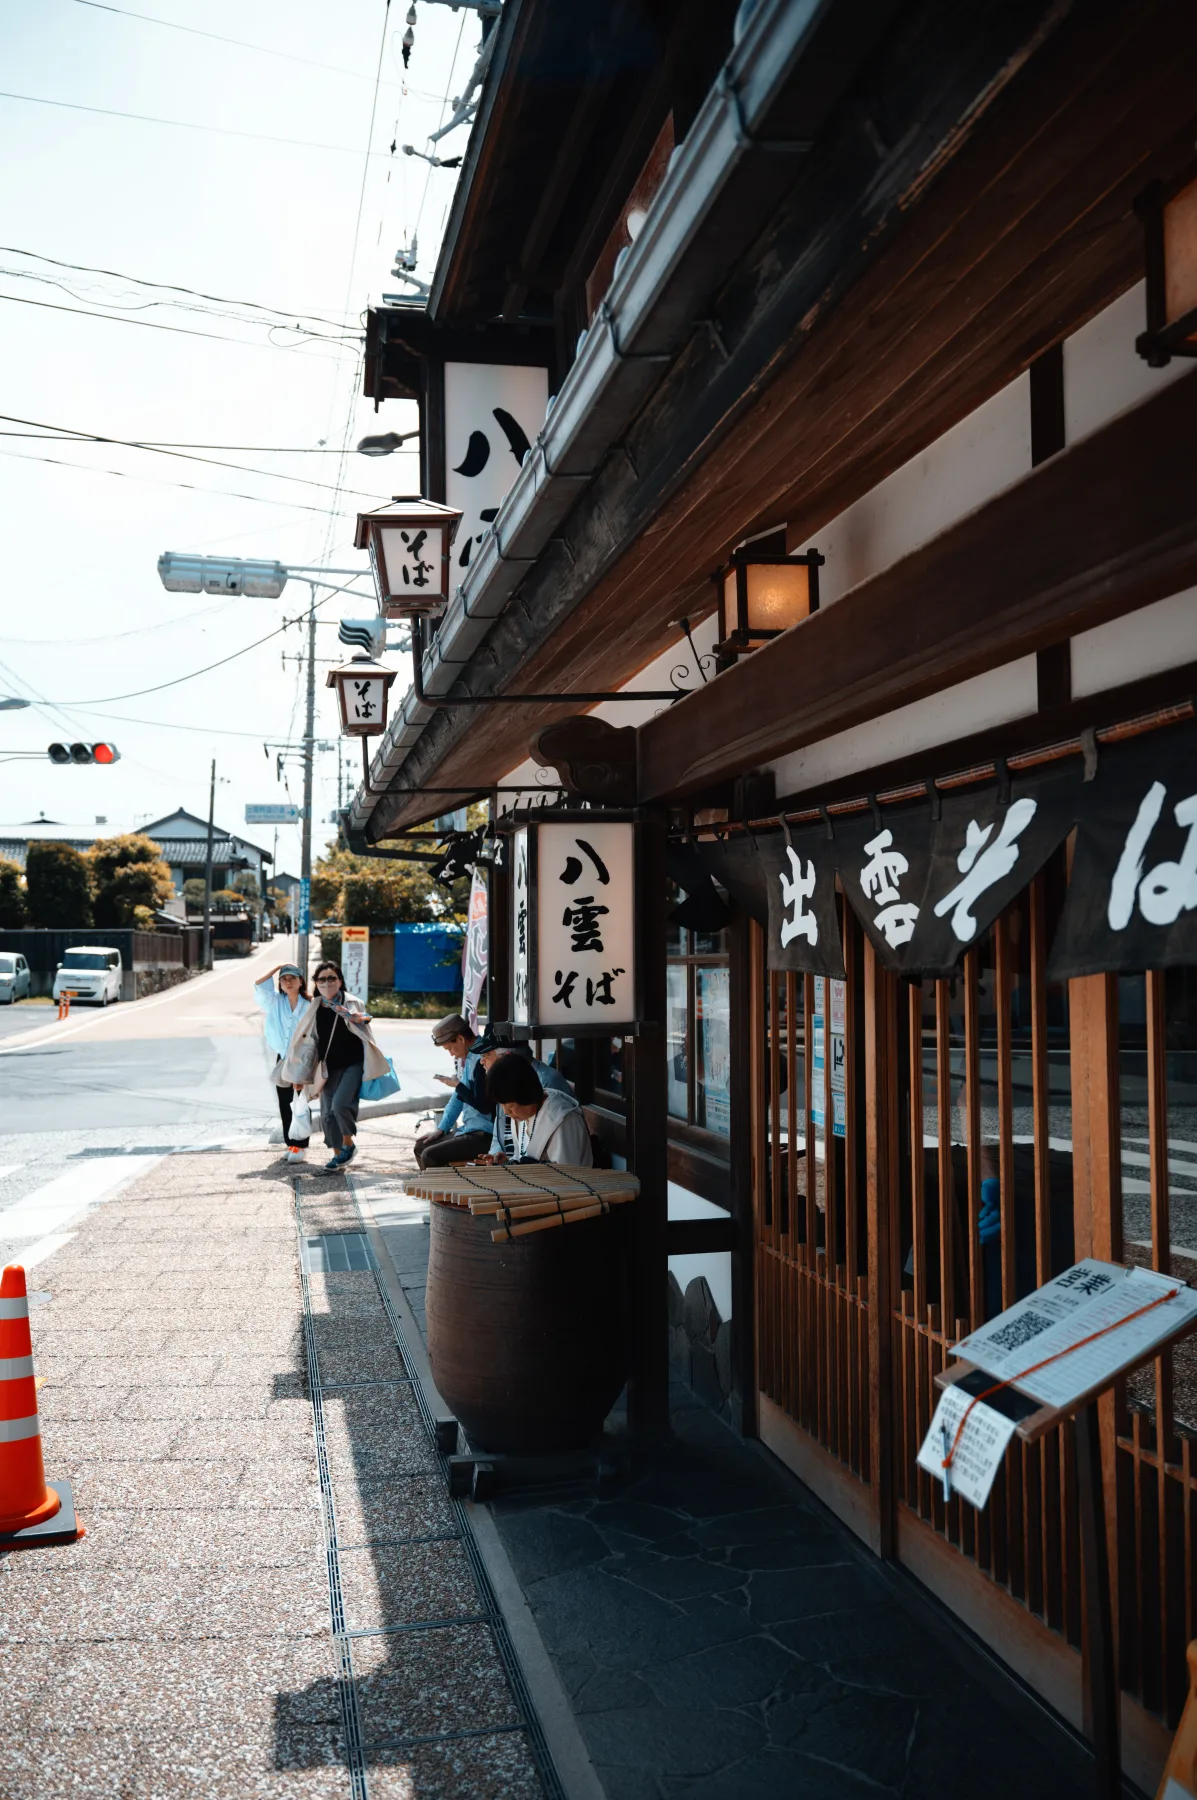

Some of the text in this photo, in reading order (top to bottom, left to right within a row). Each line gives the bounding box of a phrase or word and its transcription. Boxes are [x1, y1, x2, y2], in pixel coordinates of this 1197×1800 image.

[401, 530, 434, 587] そば
[354, 681, 376, 718] そば
[559, 839, 610, 953] 八雲
[552, 968, 626, 1009] そば
